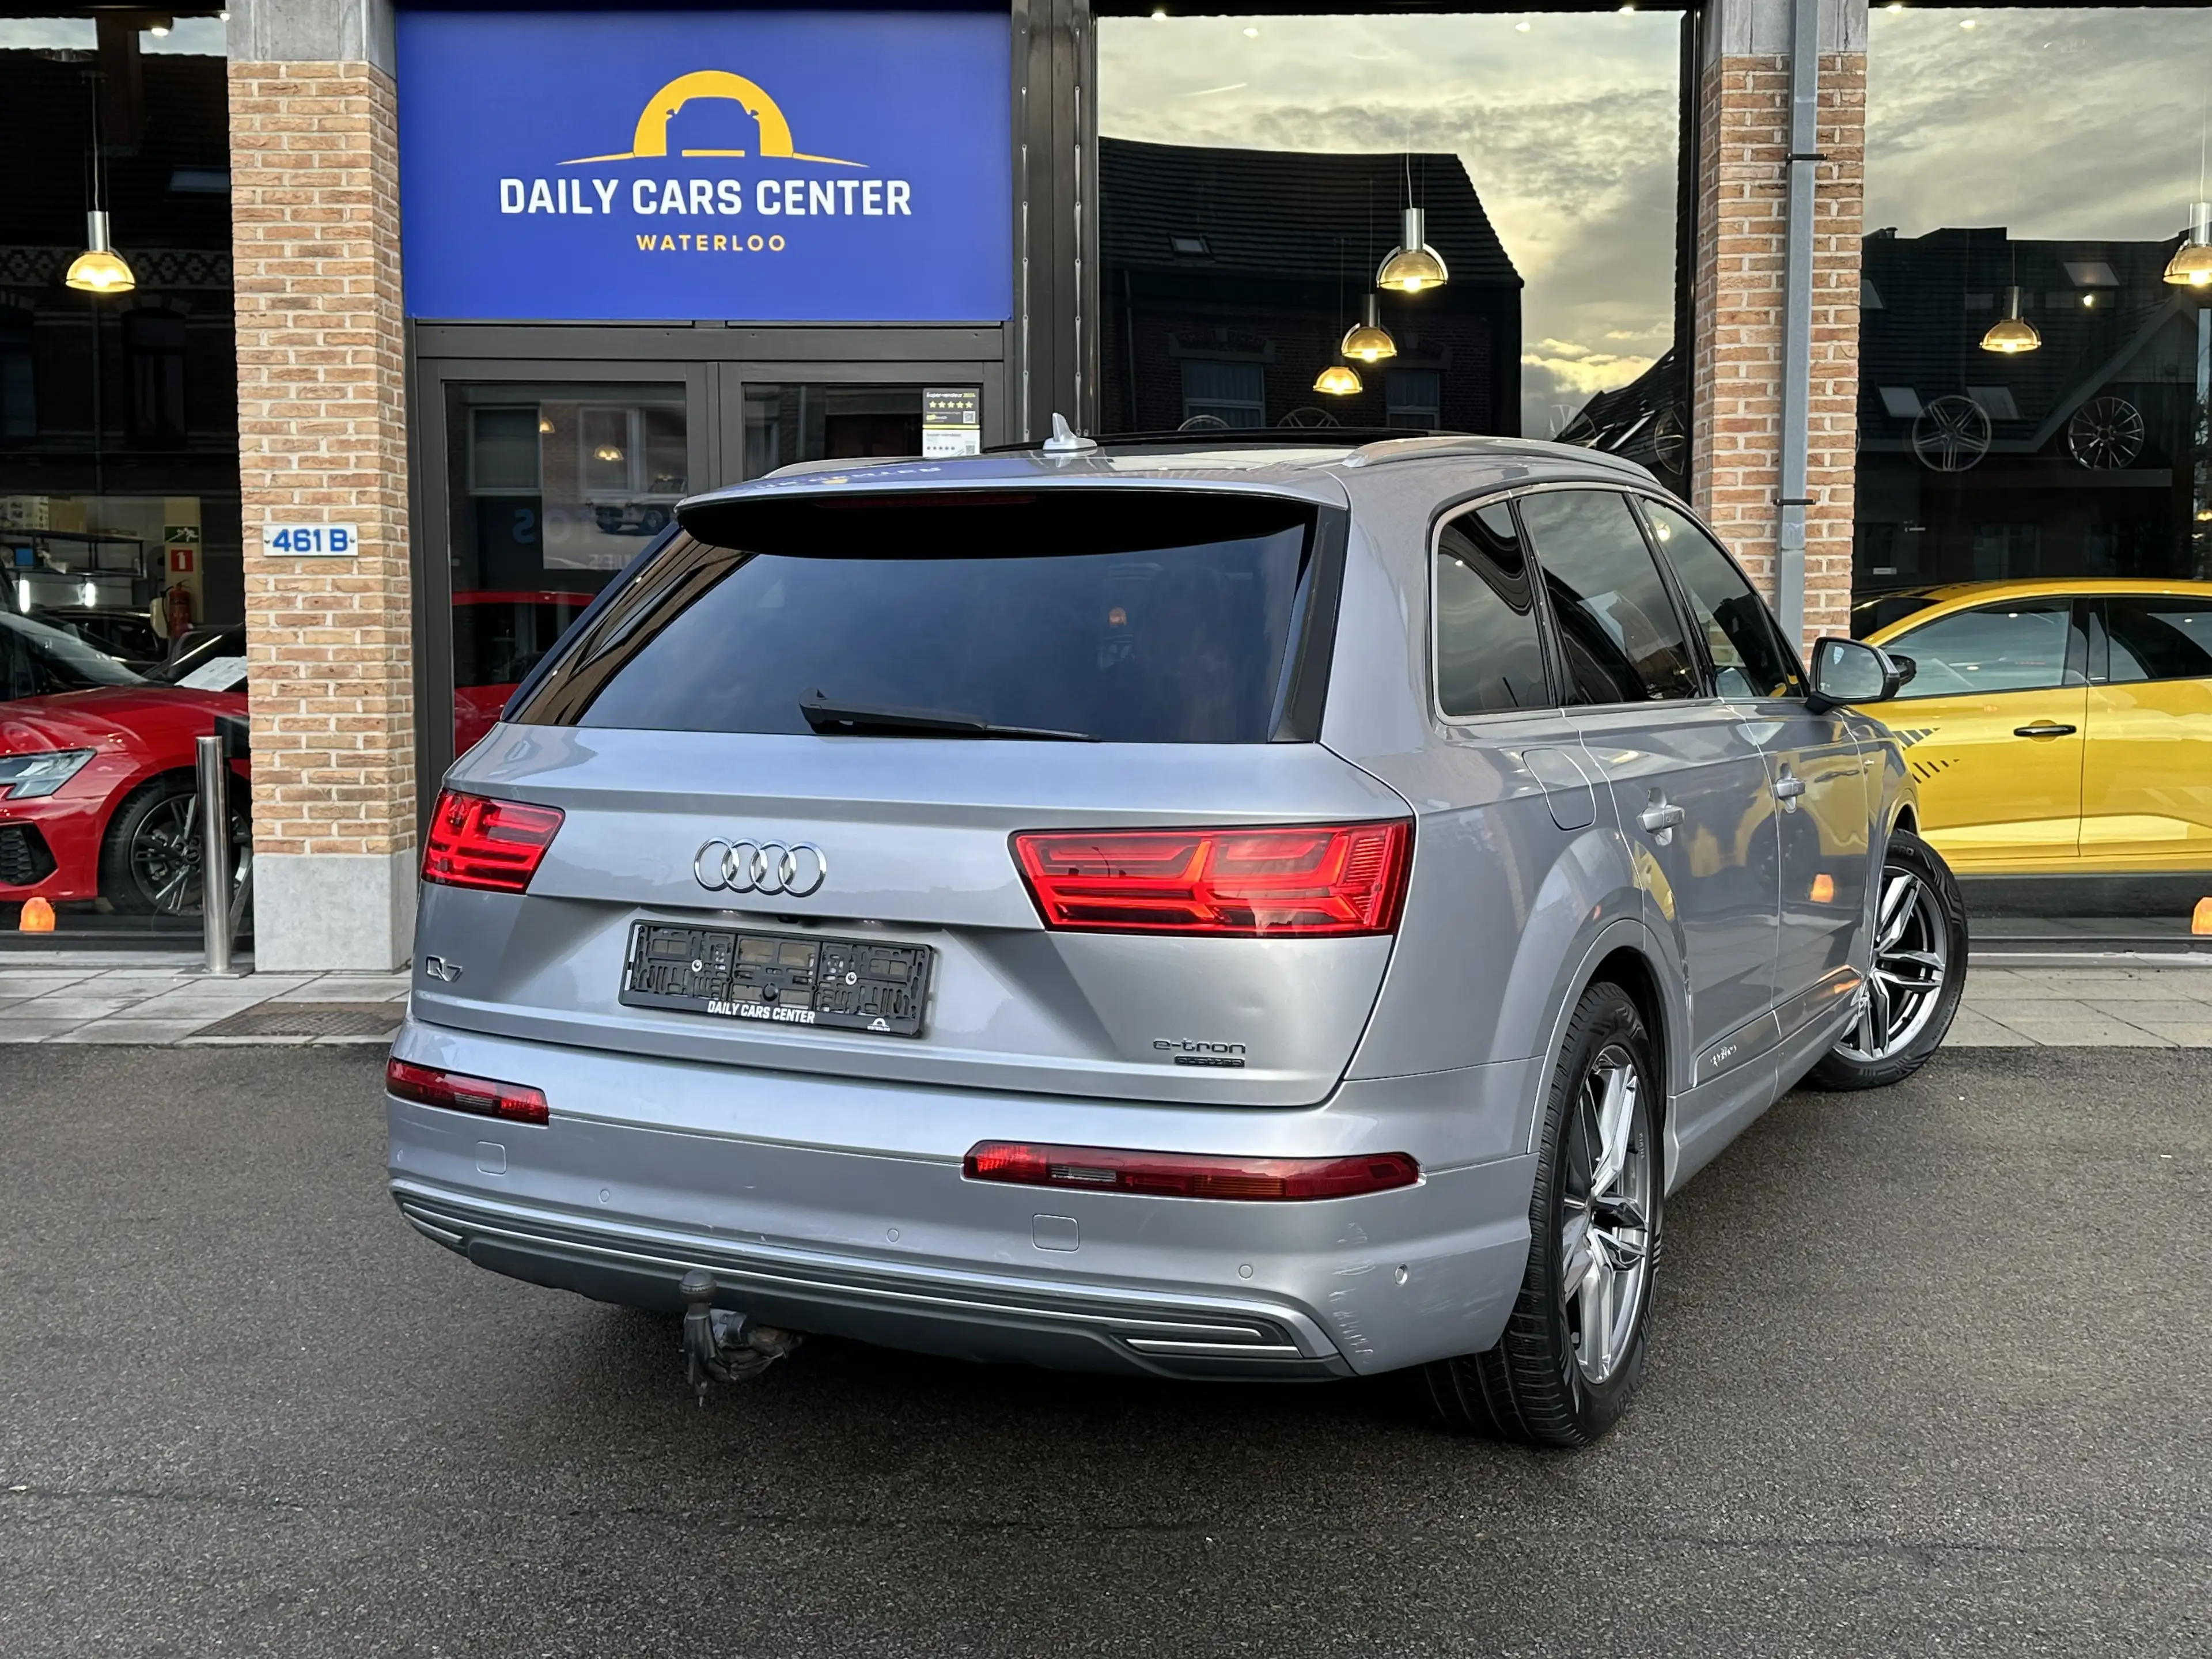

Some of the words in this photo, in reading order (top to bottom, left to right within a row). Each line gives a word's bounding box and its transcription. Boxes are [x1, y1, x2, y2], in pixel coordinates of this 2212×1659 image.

[500, 178, 619, 215] DAILY
[633, 179, 742, 215] CARS
[756, 179, 912, 216] CENTER
[636, 234, 785, 251] WATERLOO
[272, 528, 322, 552] 461
[329, 528, 348, 552] B
[426, 955, 463, 983] Q7
[707, 1001, 740, 1016] DAILY
[740, 1004, 771, 1019] CARS
[772, 1008, 816, 1024] CENTER
[1153, 1037, 1246, 1054] e-tron
